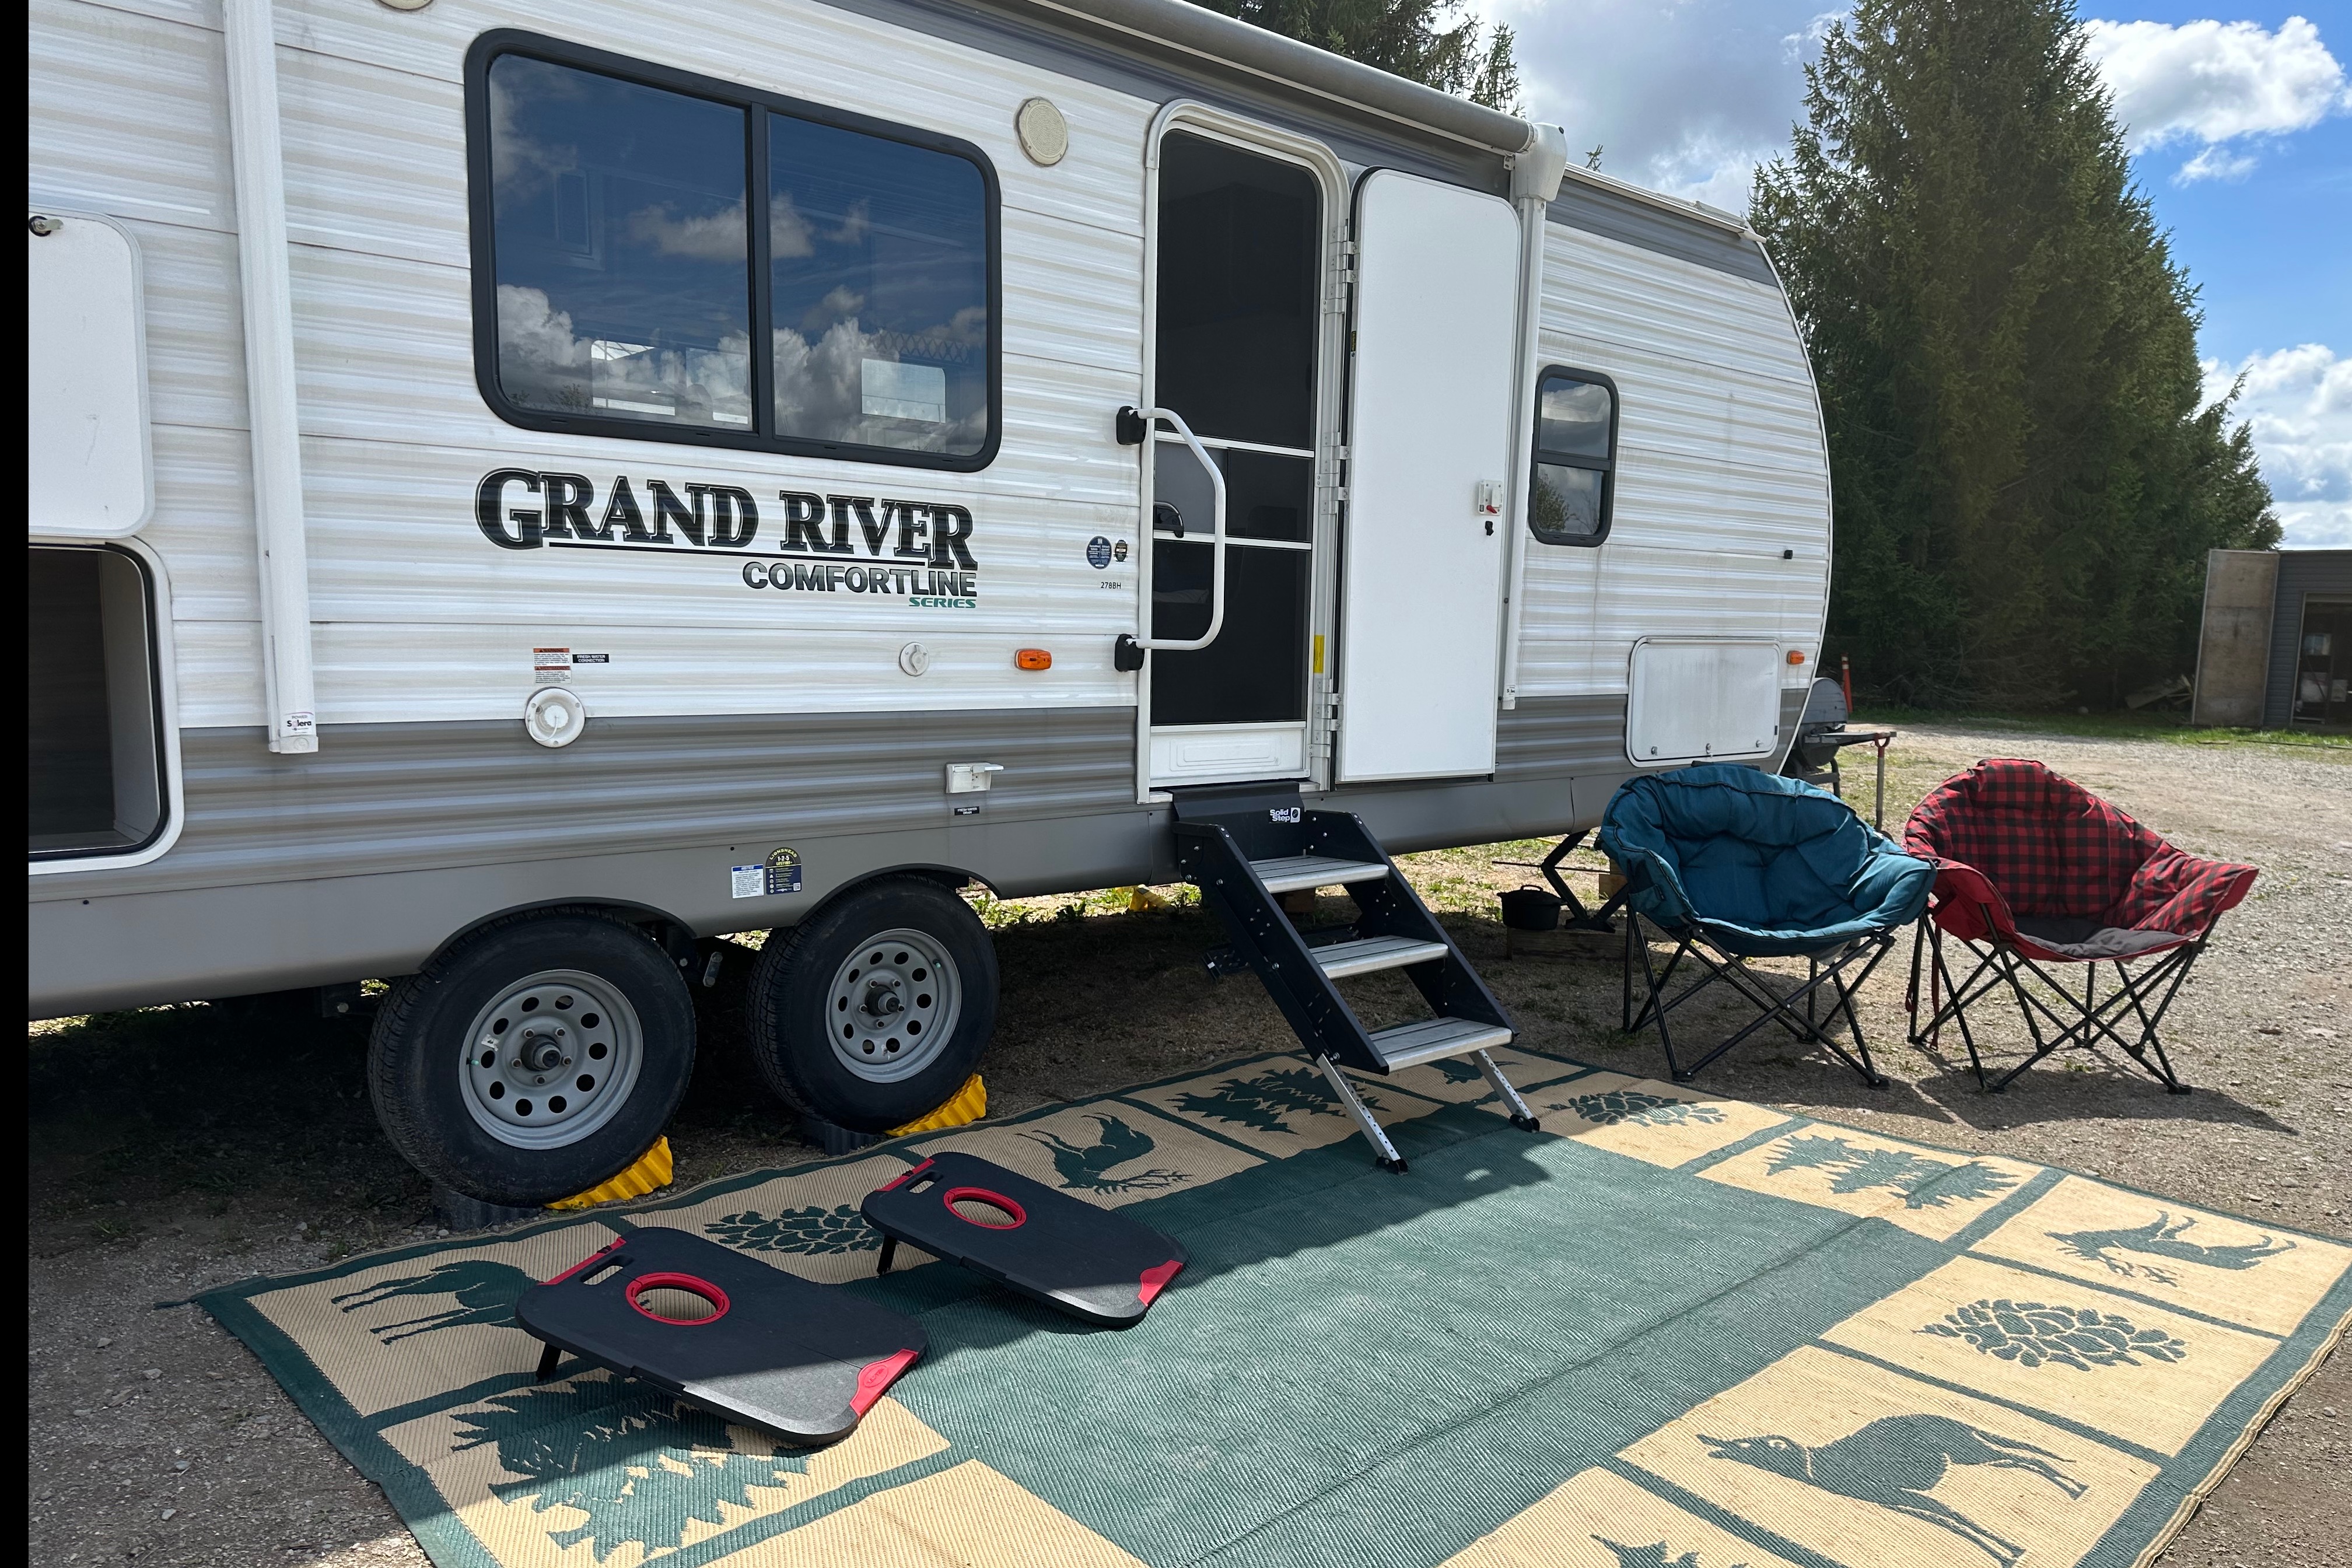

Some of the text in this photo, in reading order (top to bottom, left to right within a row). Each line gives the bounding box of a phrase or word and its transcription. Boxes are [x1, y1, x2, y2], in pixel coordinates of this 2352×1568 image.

[475, 467, 978, 570] GRAND RIVER
[742, 561, 978, 597] COMFORTLINE
[1100, 582, 1122, 590] 278BH
[908, 596, 977, 609] SERIES
[769, 848, 797, 860] LIONSHEAD
